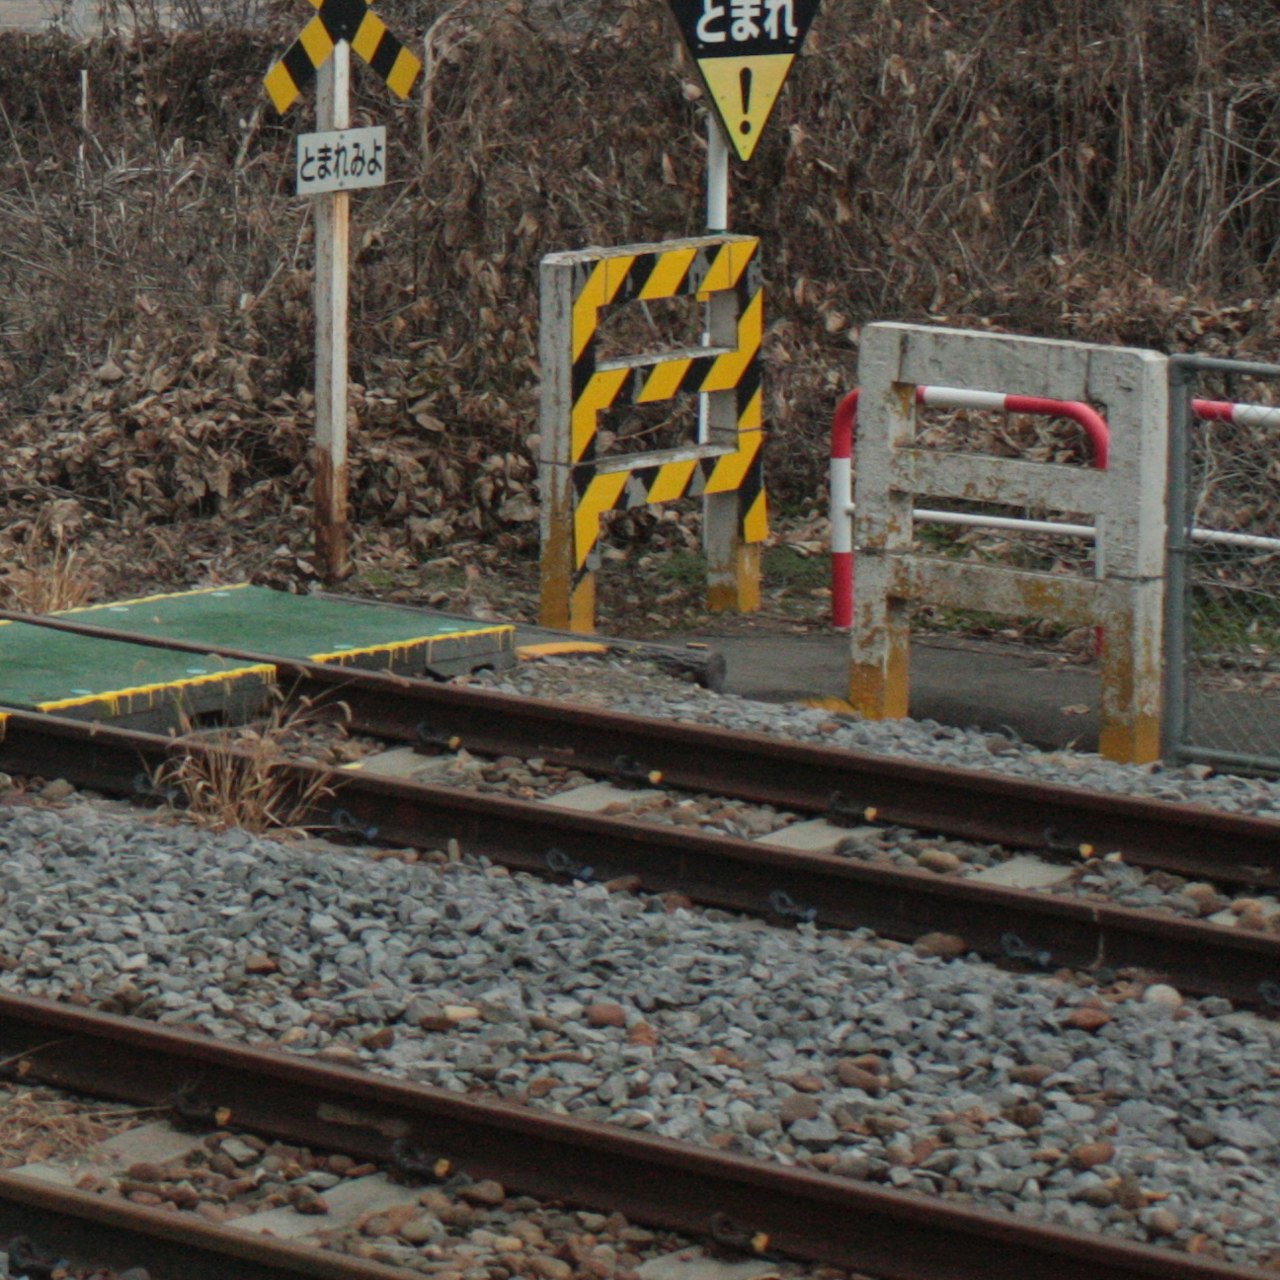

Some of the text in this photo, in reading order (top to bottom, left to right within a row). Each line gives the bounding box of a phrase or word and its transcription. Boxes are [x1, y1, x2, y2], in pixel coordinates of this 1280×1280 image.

[300, 137, 383, 182] とまれみよ
